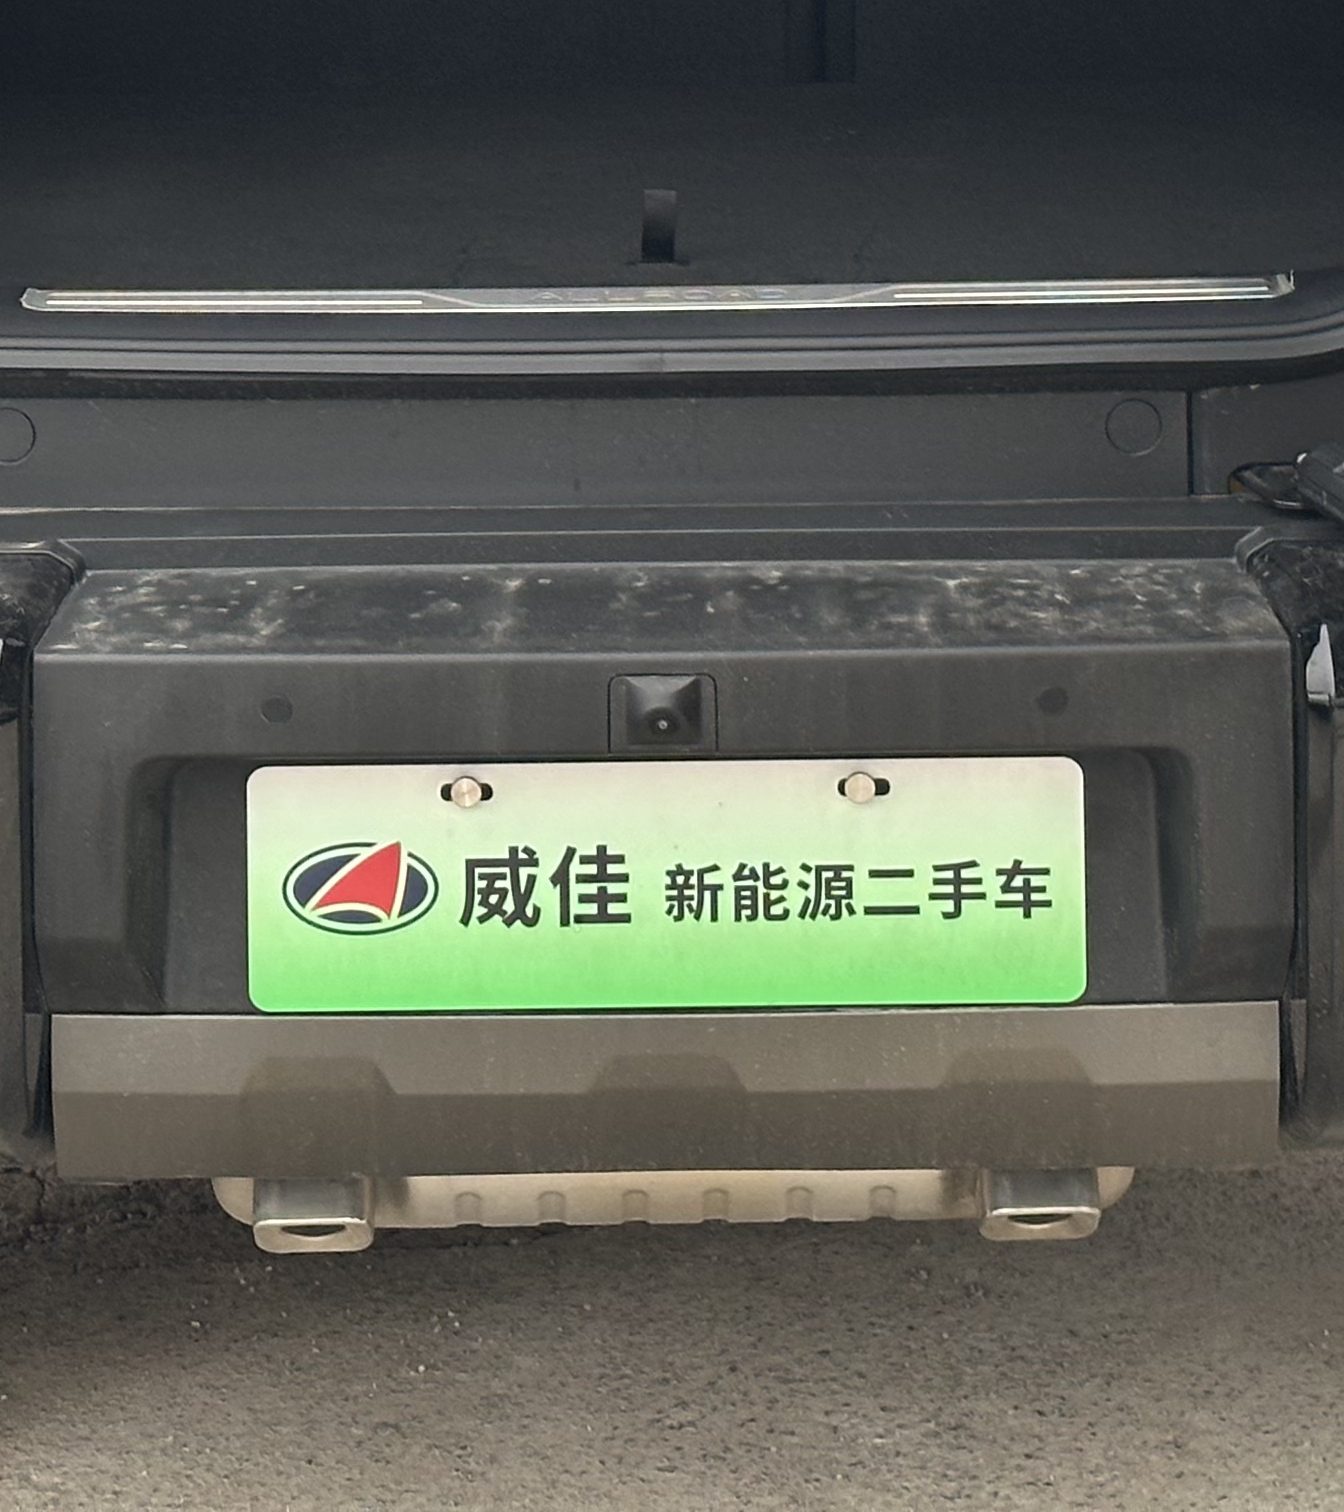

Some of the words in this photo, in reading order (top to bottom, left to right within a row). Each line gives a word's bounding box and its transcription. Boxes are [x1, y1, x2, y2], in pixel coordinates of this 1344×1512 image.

[460, 845, 632, 928] 威佳
[665, 859, 1053, 923] 新能源二手车
